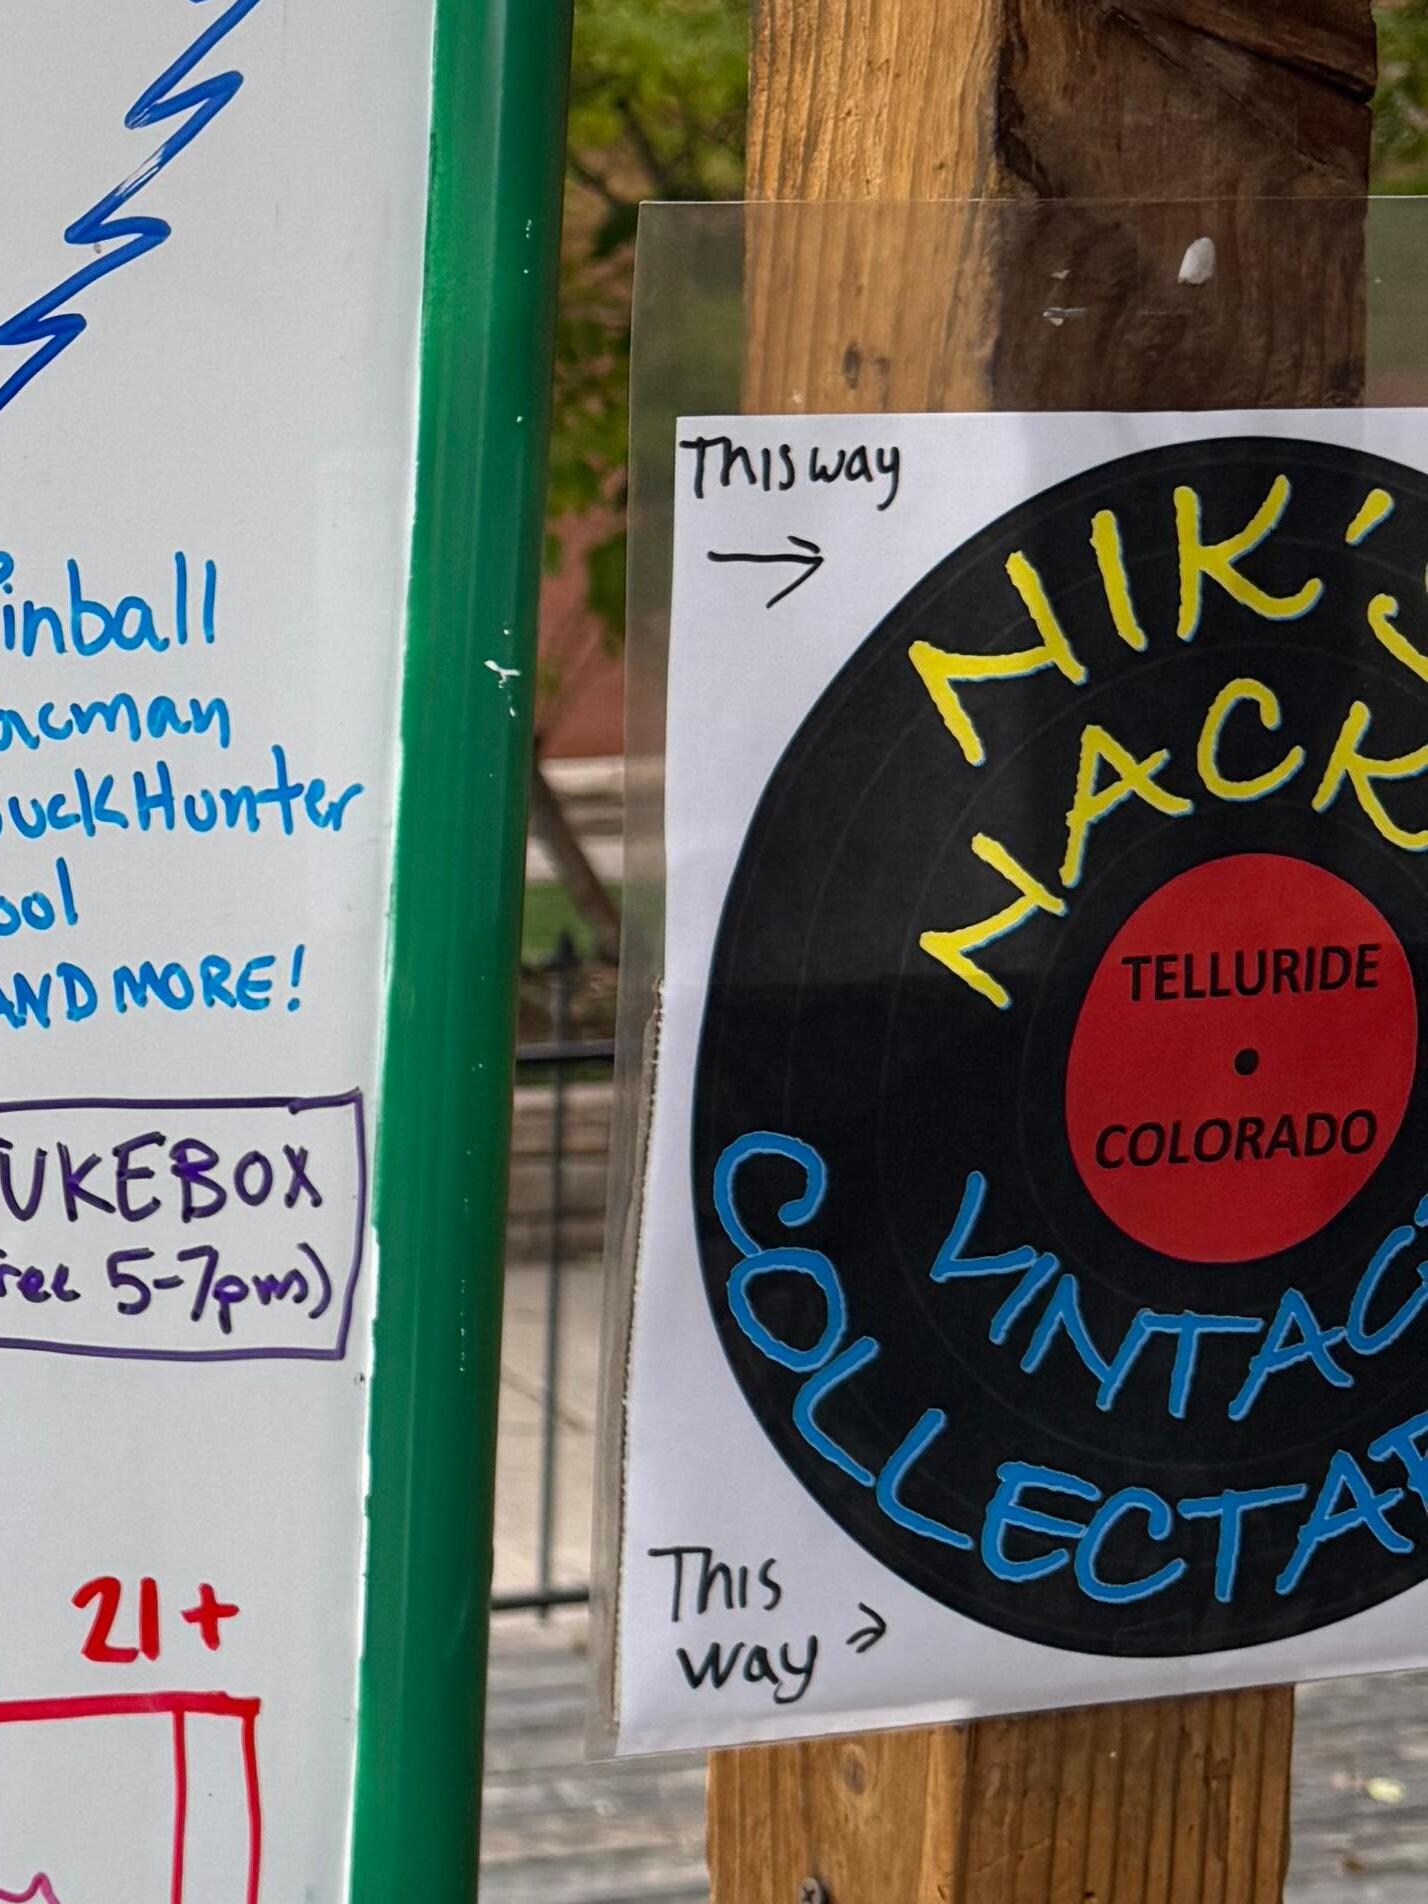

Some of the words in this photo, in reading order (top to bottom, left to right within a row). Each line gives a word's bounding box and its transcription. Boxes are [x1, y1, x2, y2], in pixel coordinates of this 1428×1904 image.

[1120, 941, 1383, 1003] TELLURIDE
[1094, 1107, 1380, 1172] COLORADO
[105, 1241, 334, 1336] 5-7pm)
[929, 1174, 1428, 1421] VINTAG
[70, 1575, 241, 1665] 21+
[647, 1545, 783, 1621] This
[676, 1634, 819, 1706] way
